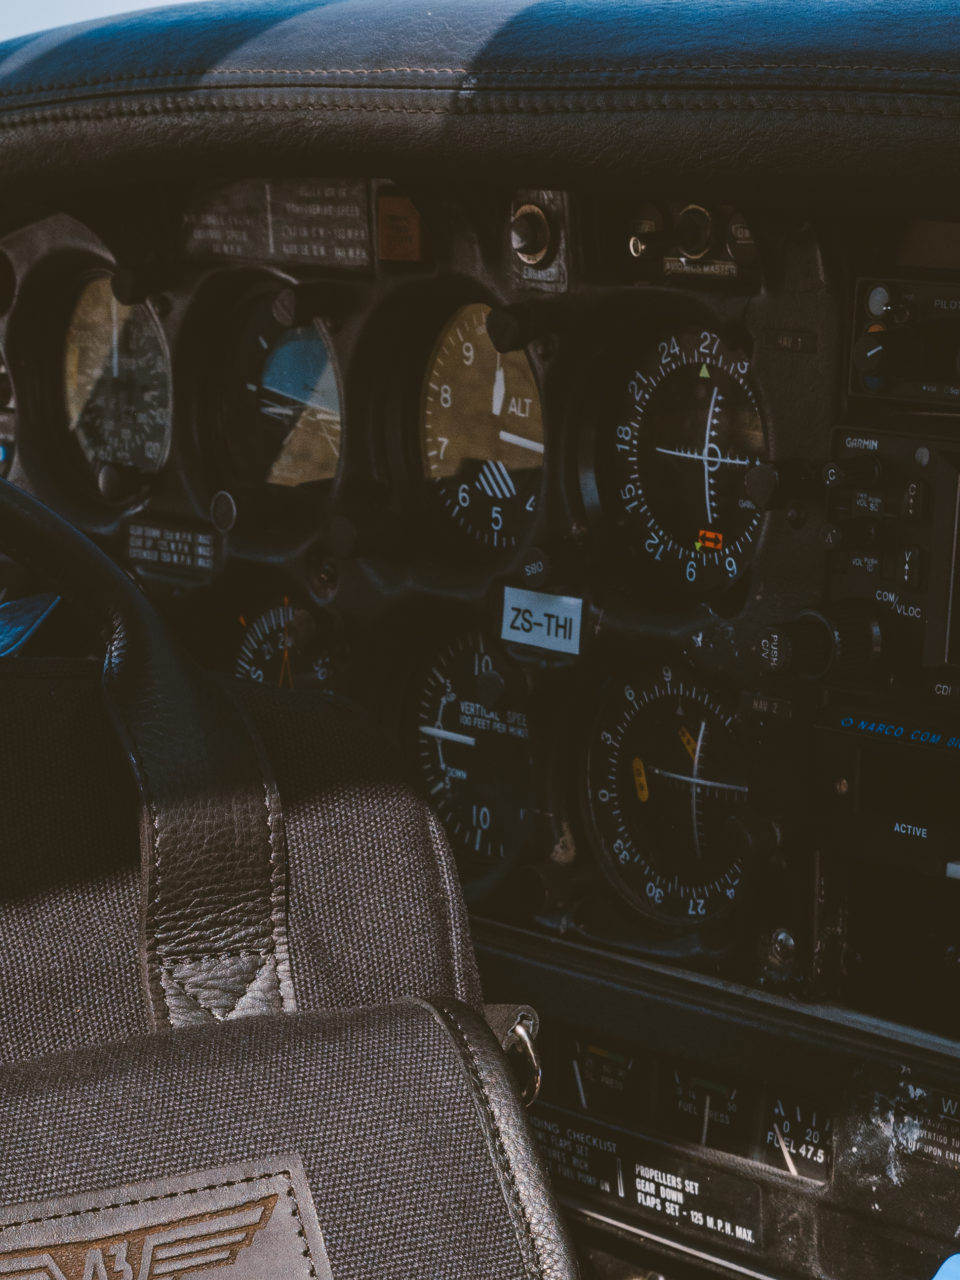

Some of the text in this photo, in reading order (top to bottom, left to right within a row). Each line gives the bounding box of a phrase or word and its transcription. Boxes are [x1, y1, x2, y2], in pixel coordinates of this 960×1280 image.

[462, 342, 474, 366] 9
[659, 336, 681, 364] 24
[700, 331, 720, 354] 27
[440, 385, 452, 408] 8
[628, 370, 648, 400] 21
[507, 396, 532, 418] ALT
[437, 437, 449, 460] 7
[616, 425, 632, 452] 18
[845, 437, 879, 451] GARMIN
[458, 484, 470, 508] 6
[491, 506, 503, 531] 5
[510, 606, 573, 641] ZS-THI
[896, 604, 921, 619] VLOC
[769, 633, 779, 667] PUSH
[473, 652, 493, 676] 10
[934, 683, 952, 697] CDI
[506, 710, 528, 728] SPEE
[857, 720, 905, 738] NARCO
[910, 729, 942, 745] COM
[446, 768, 468, 781] DOWN
[472, 804, 491, 830] 10
[893, 822, 929, 839] ACTIVE
[565, 1127, 617, 1154] CHECKLIST
[782, 1120, 820, 1144] 0 20
[767, 1131, 825, 1164] FUEL 47.5
[923, 1145, 943, 1158] UPON
[634, 1163, 700, 1196] PROPELLERS SET
[634, 1178, 684, 1205] GEAR DOWN
[636, 1190, 662, 1212] FLAPS
[664, 1200, 680, 1217] SET
[689, 1209, 705, 1226] 125
[705, 1212, 734, 1237] M.P.H.
[734, 1223, 756, 1245] MAX.
